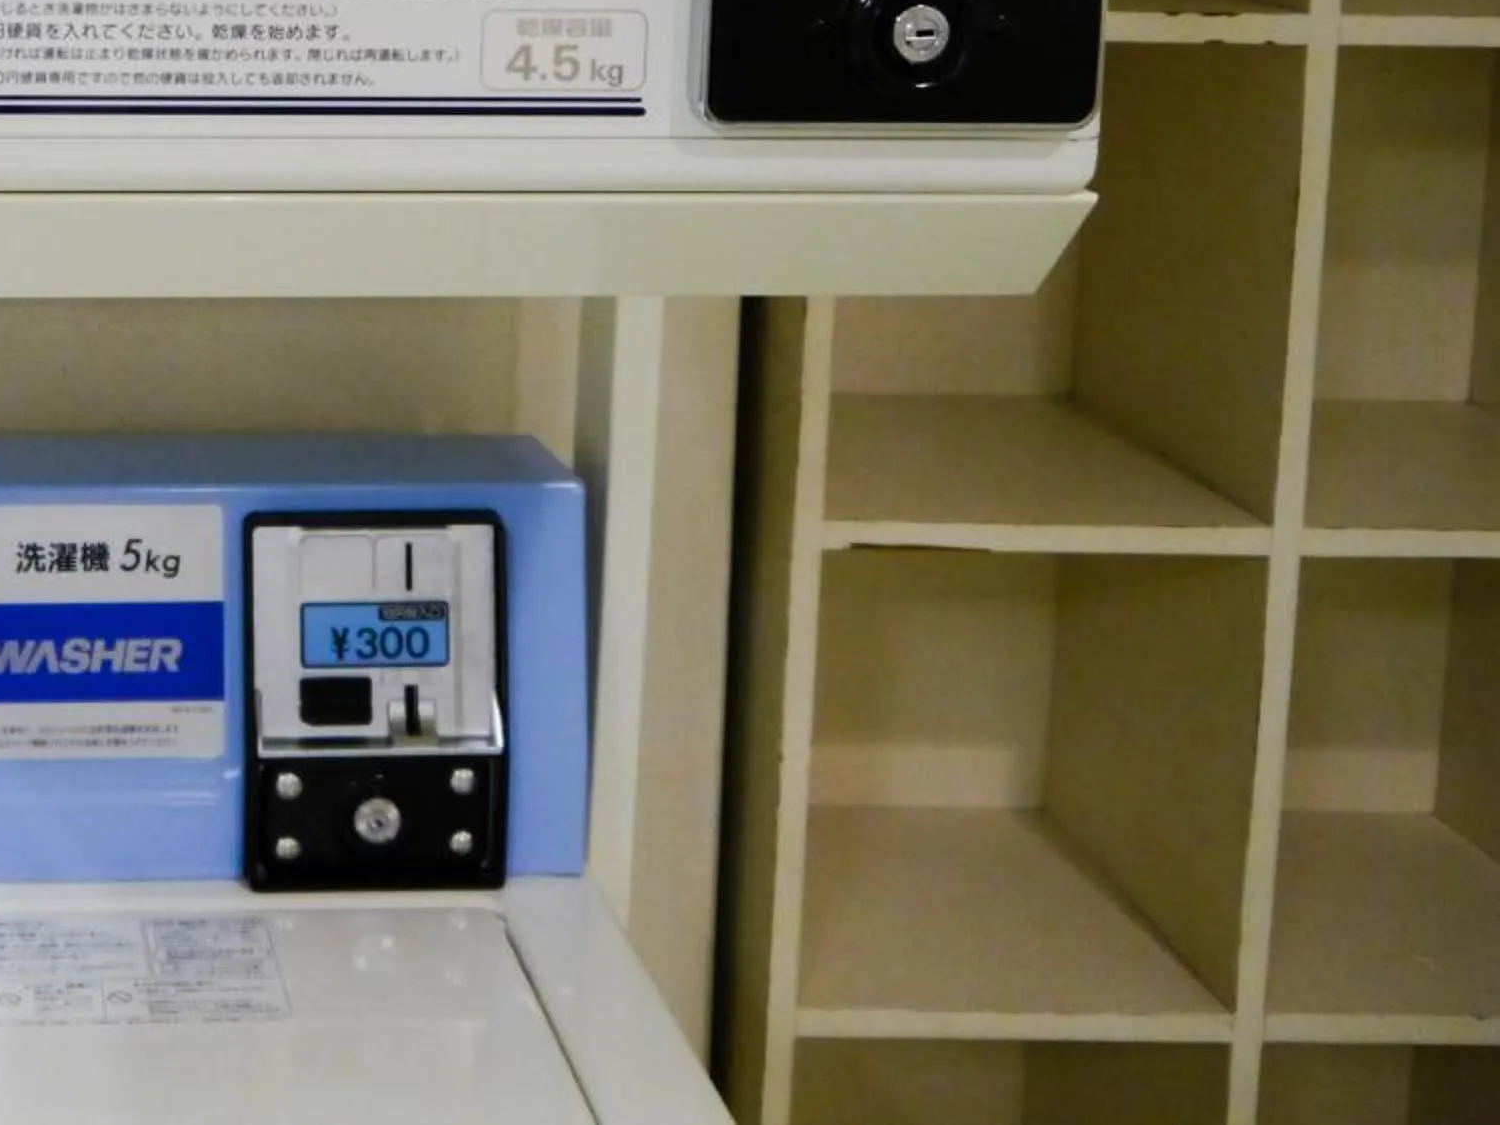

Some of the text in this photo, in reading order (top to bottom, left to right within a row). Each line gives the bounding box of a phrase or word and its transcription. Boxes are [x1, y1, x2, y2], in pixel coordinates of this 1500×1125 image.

[15, 538, 182, 579] 洗濯機 5kg
[331, 626, 431, 660] ¥300
